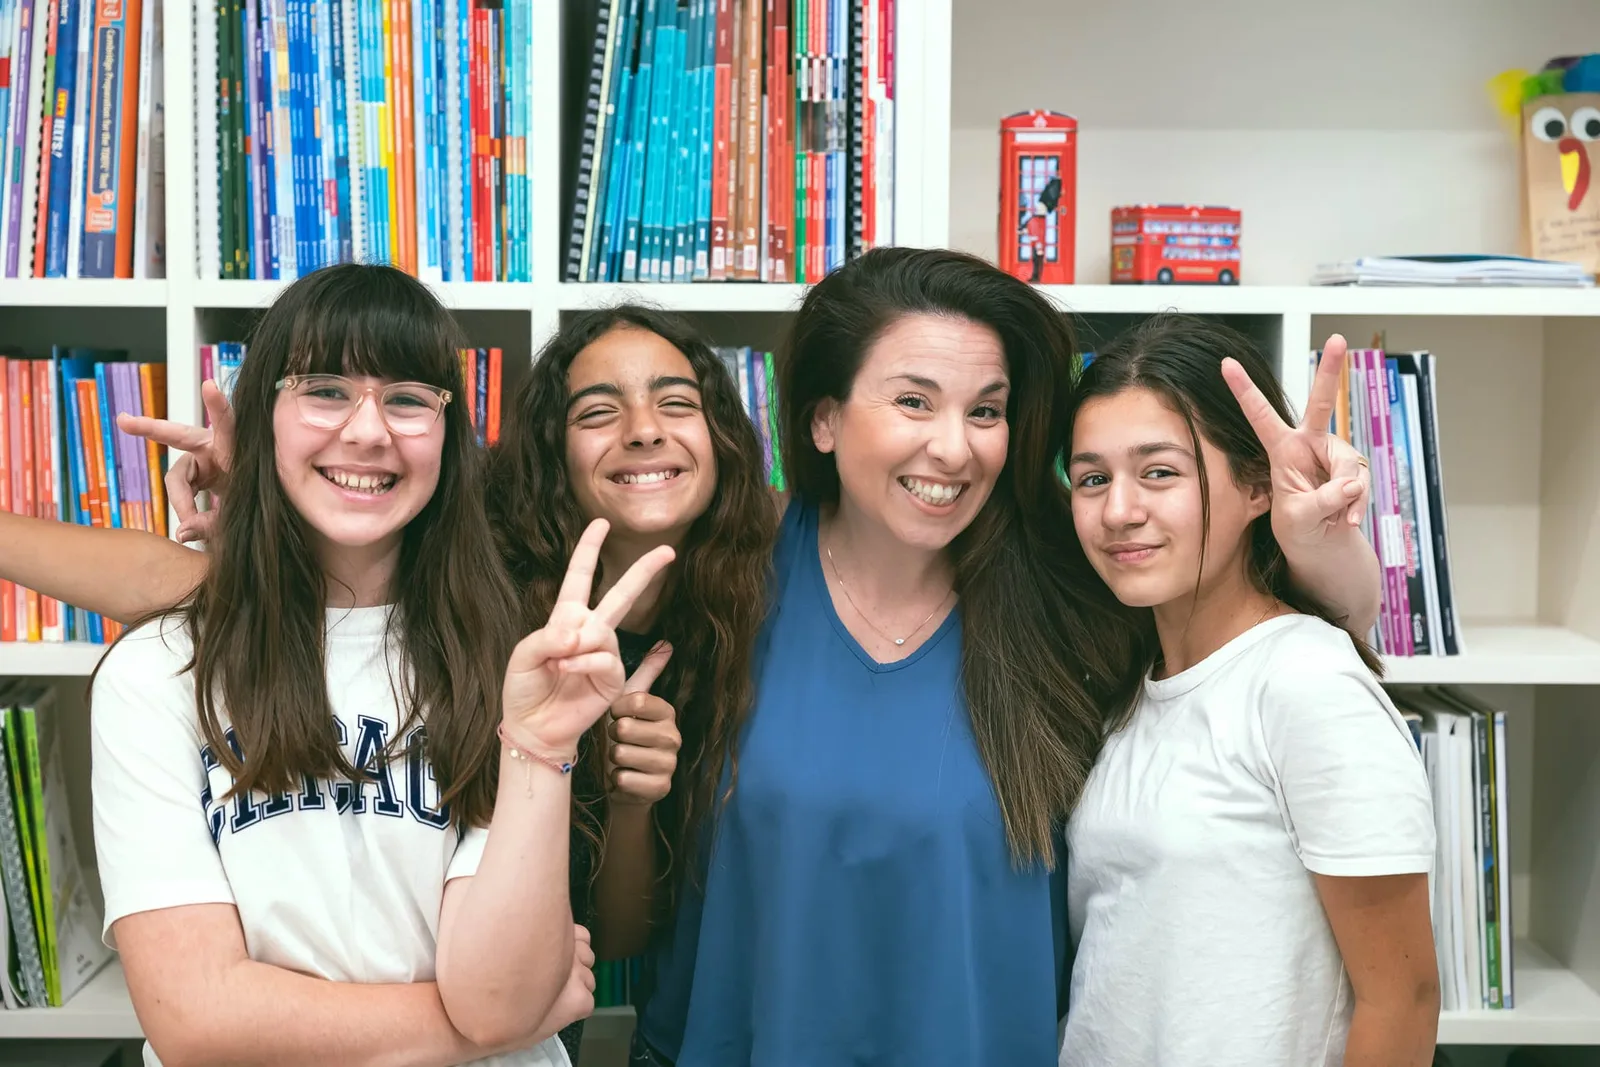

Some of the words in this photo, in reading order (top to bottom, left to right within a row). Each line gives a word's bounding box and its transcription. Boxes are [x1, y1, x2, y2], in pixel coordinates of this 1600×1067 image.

[103, 28, 116, 71] Cambridge
[102, 72, 114, 119] Preparation
[715, 226, 724, 241] 2
[746, 227, 756, 240] 3
